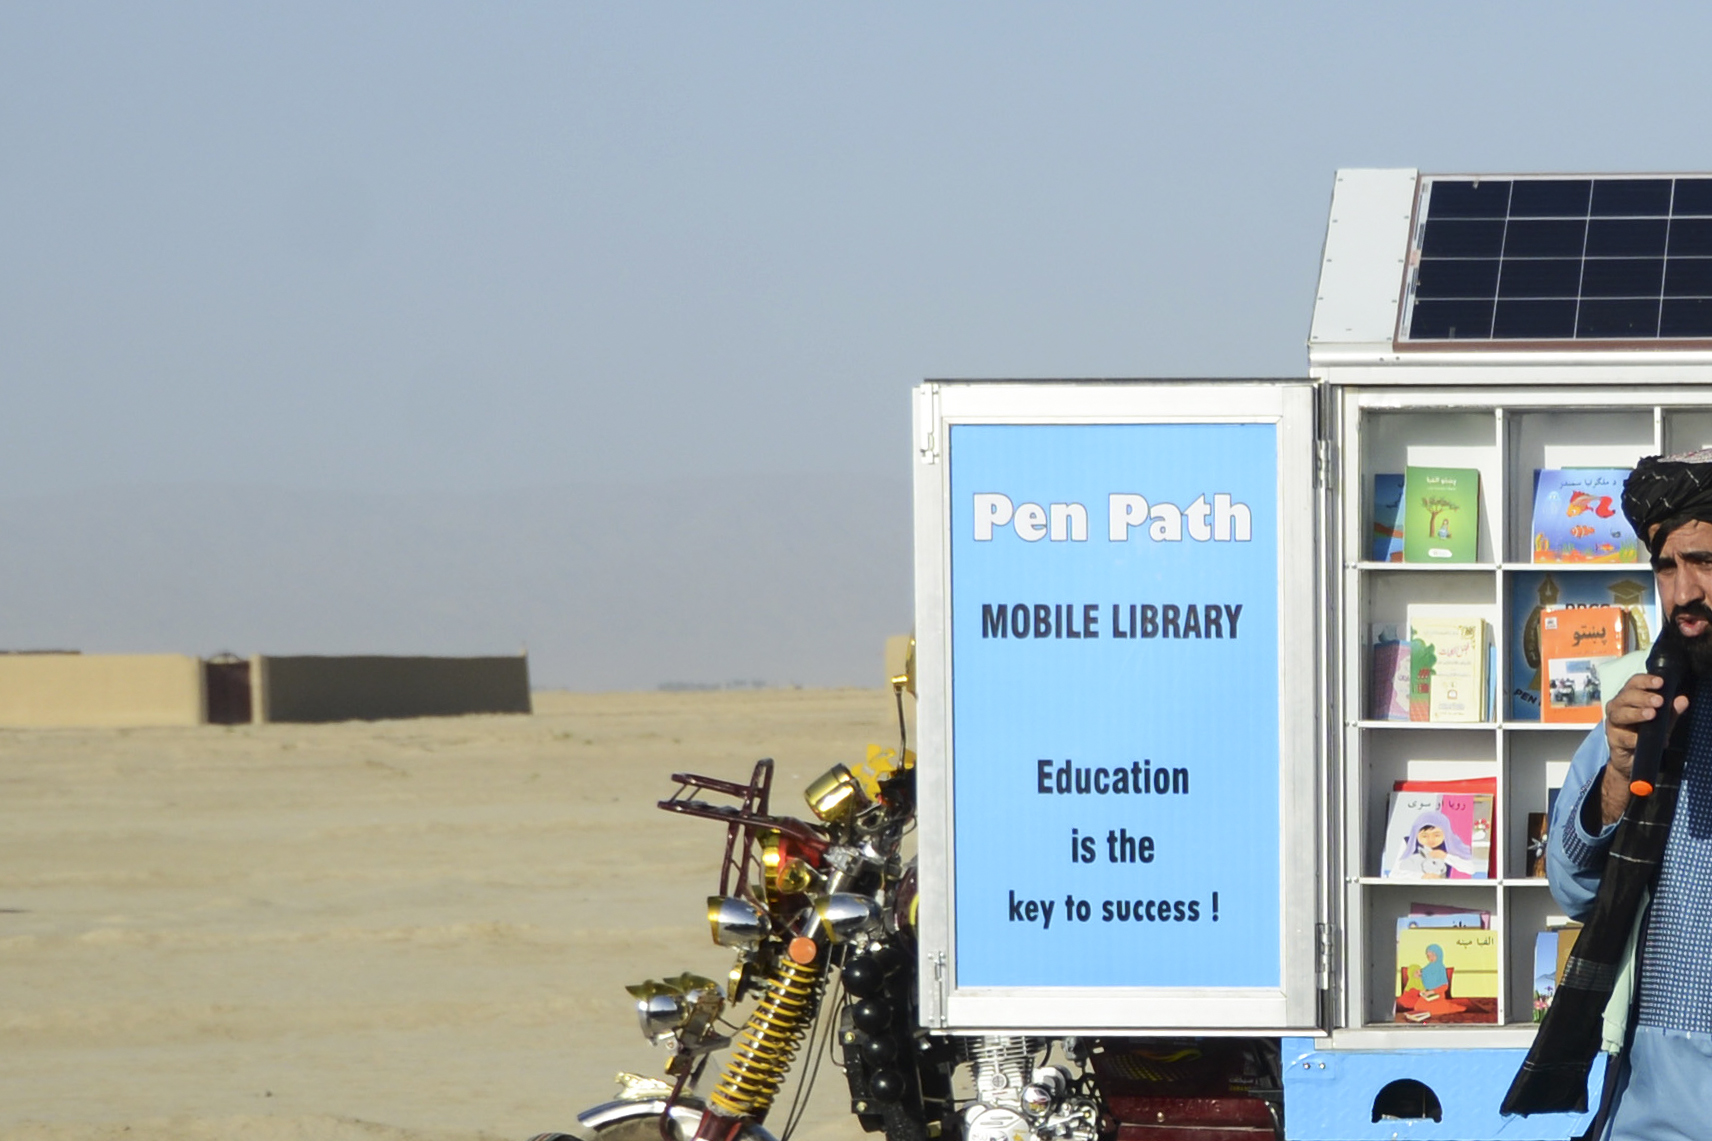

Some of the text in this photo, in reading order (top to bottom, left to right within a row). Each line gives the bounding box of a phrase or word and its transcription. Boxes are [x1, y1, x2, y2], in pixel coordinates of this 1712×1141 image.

[973, 492, 1253, 542] Pen Path
[981, 604, 1244, 639] MOBILE LIBRARY
[1572, 625, 1608, 646] پښتو
[1513, 688, 1538, 705] PEN
[1037, 759, 1189, 795] Education
[1071, 827, 1156, 863] is the
[1008, 889, 1054, 930] key
[1065, 893, 1091, 923] to
[1101, 898, 1200, 924] success
